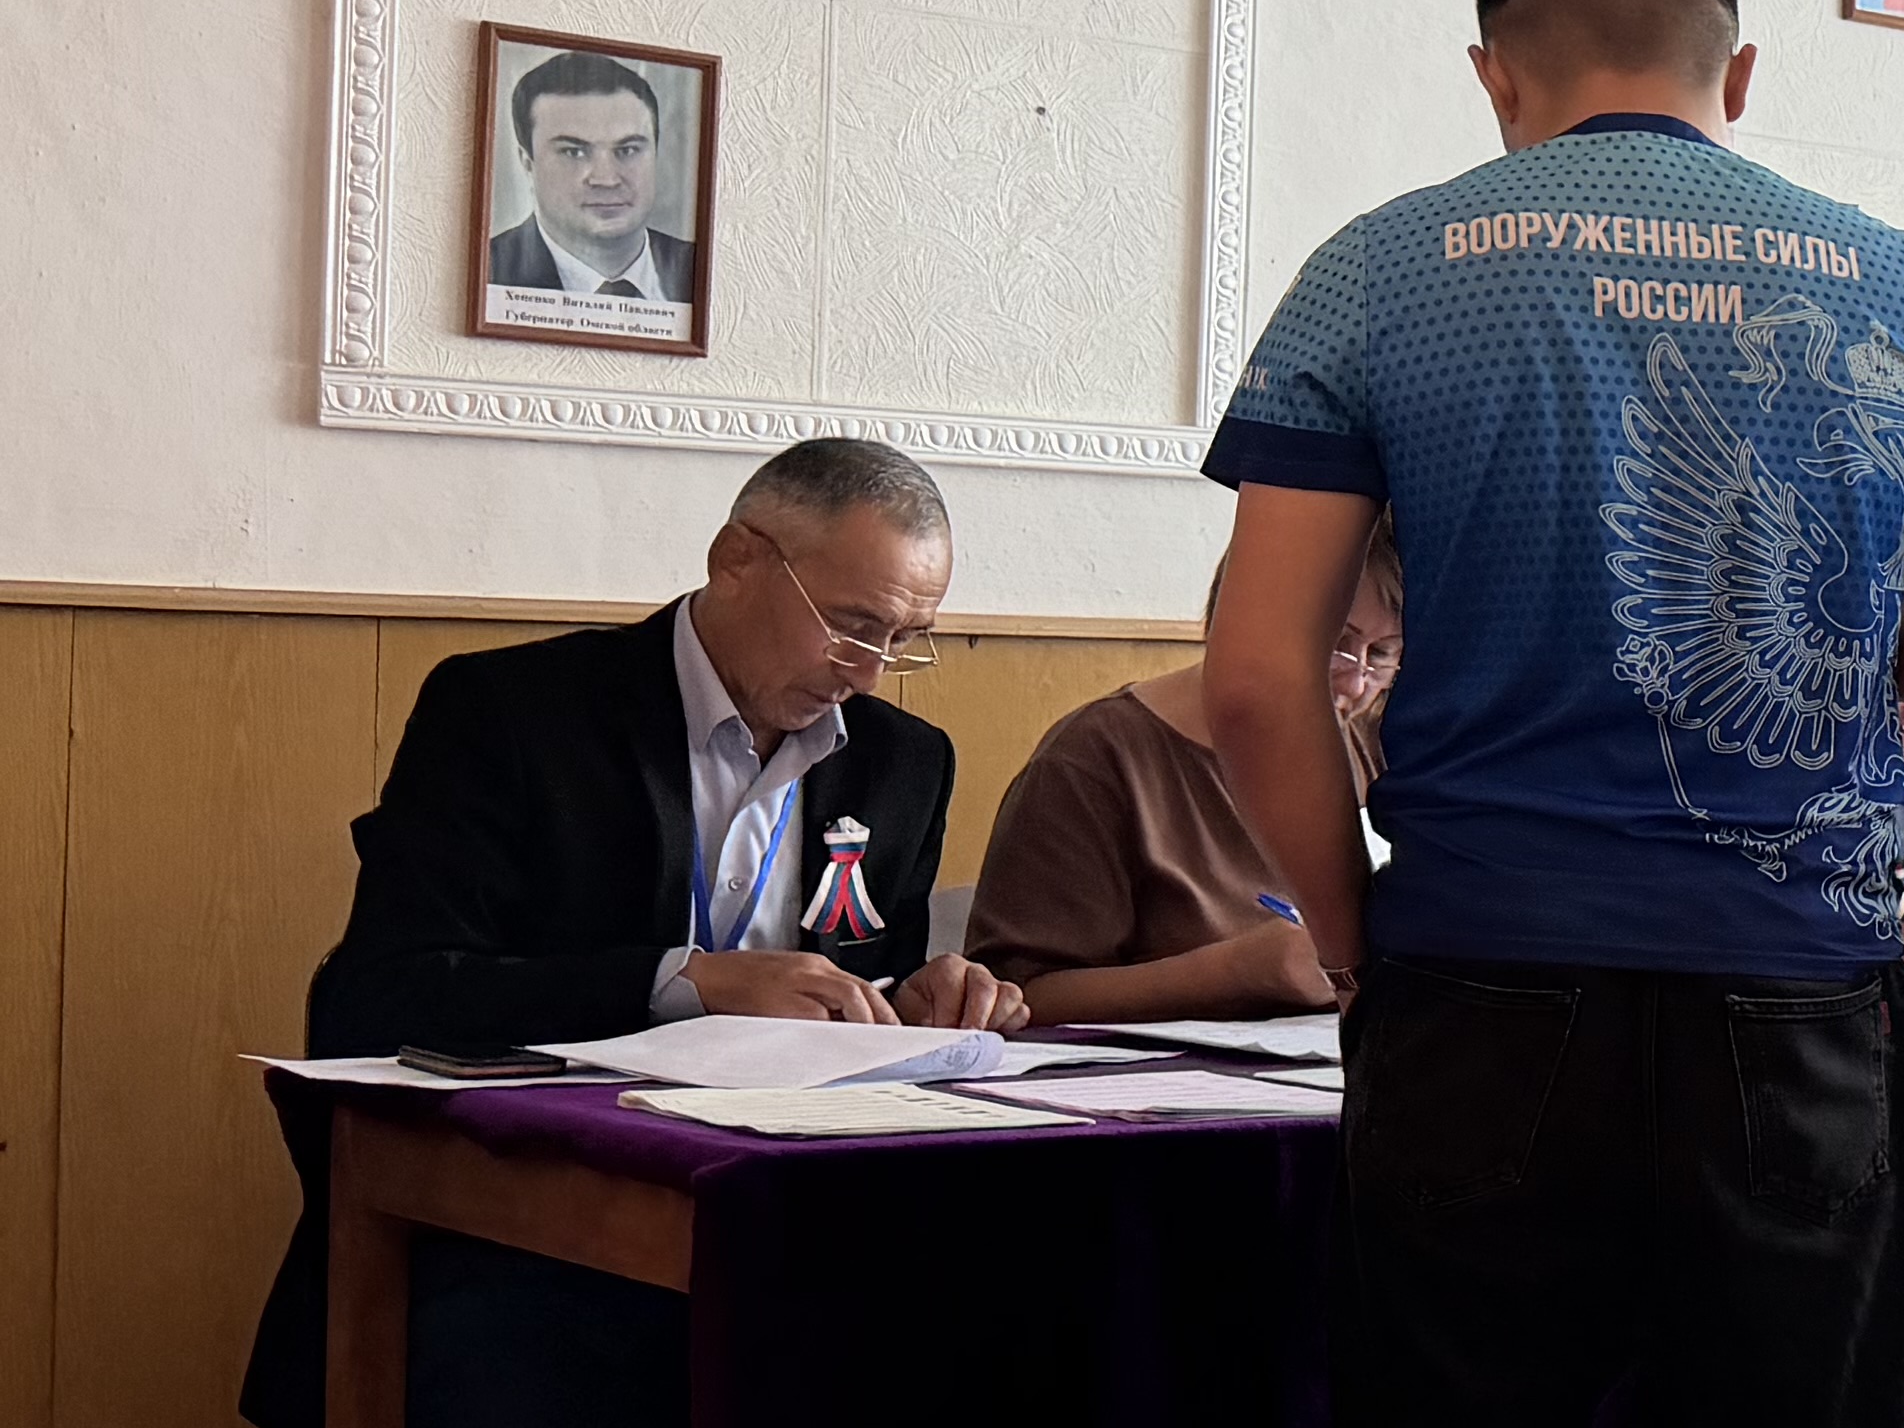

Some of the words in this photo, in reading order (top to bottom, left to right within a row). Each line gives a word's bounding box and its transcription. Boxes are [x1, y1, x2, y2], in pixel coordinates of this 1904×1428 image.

[1444, 212, 1747, 264] ВООРУЖЕННЫЕ
[1755, 223, 1860, 281] СИЛЫ
[1593, 276, 1744, 325] РОССИИ
